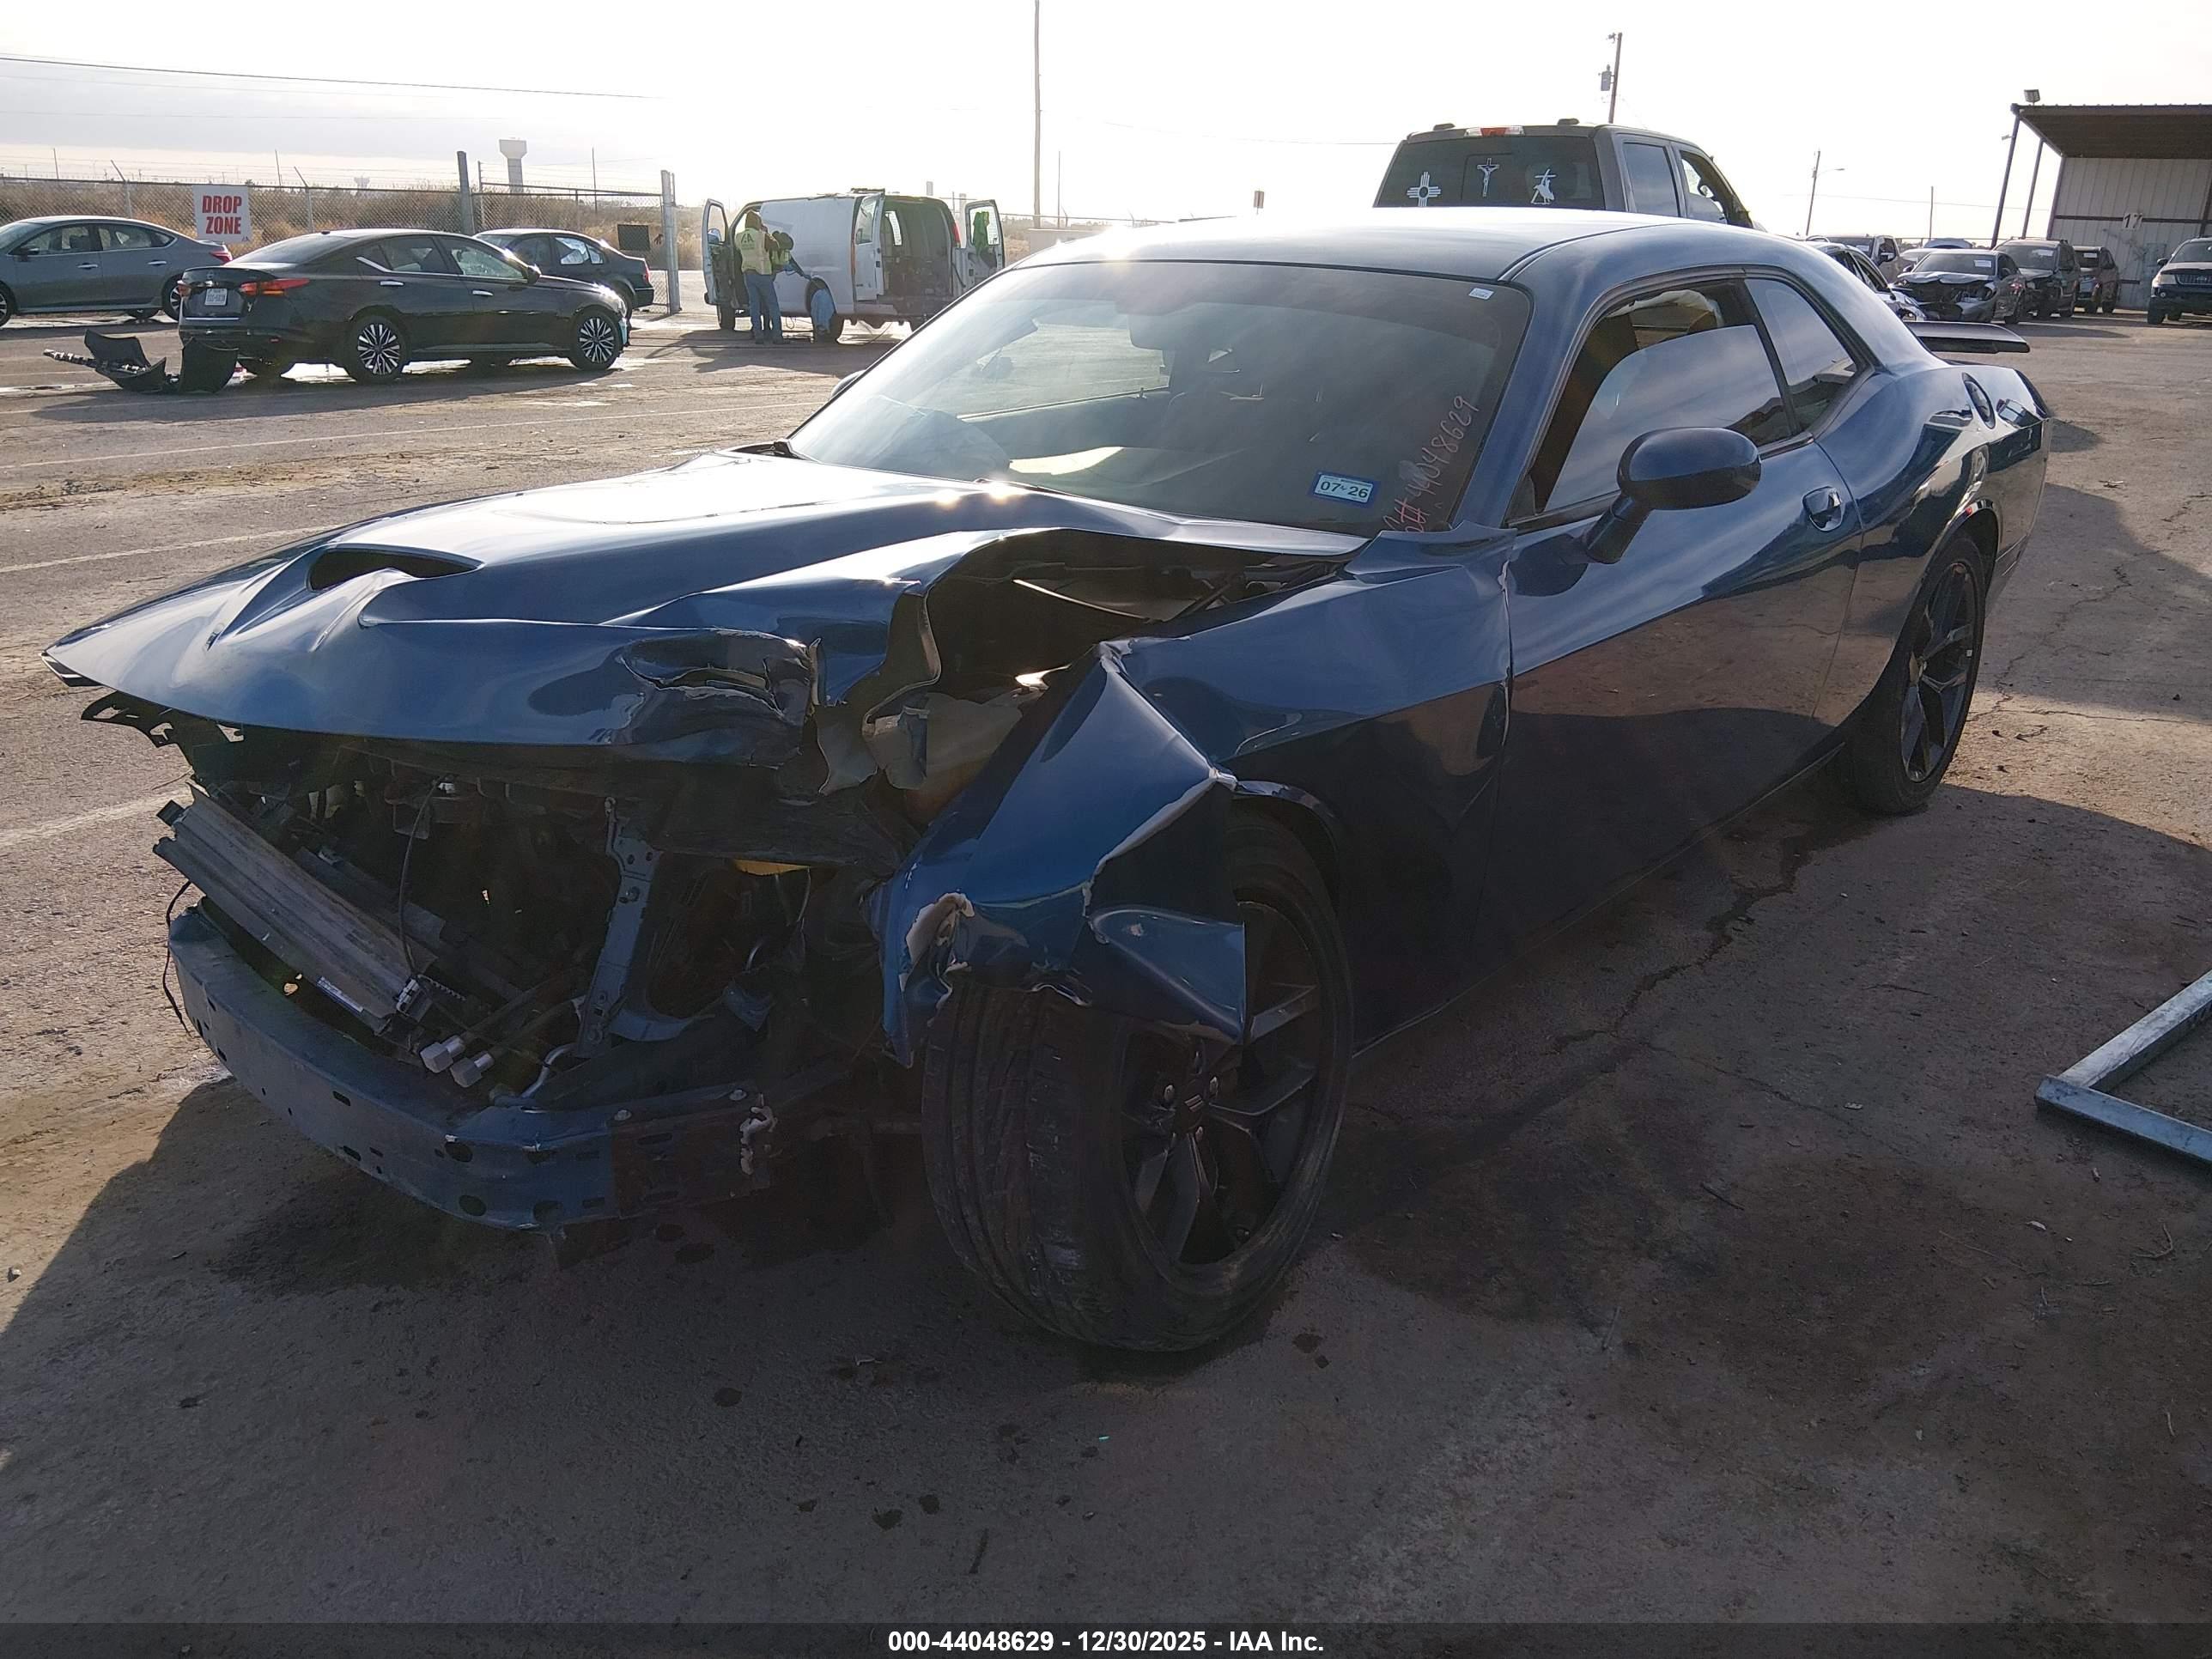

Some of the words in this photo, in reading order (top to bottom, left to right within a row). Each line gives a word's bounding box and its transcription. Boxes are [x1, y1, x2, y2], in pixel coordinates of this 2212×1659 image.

[202, 195, 242, 214] DROP
[205, 216, 241, 234] ZONE
[1320, 481, 1341, 492] 07
[1347, 486, 1369, 498] 26
